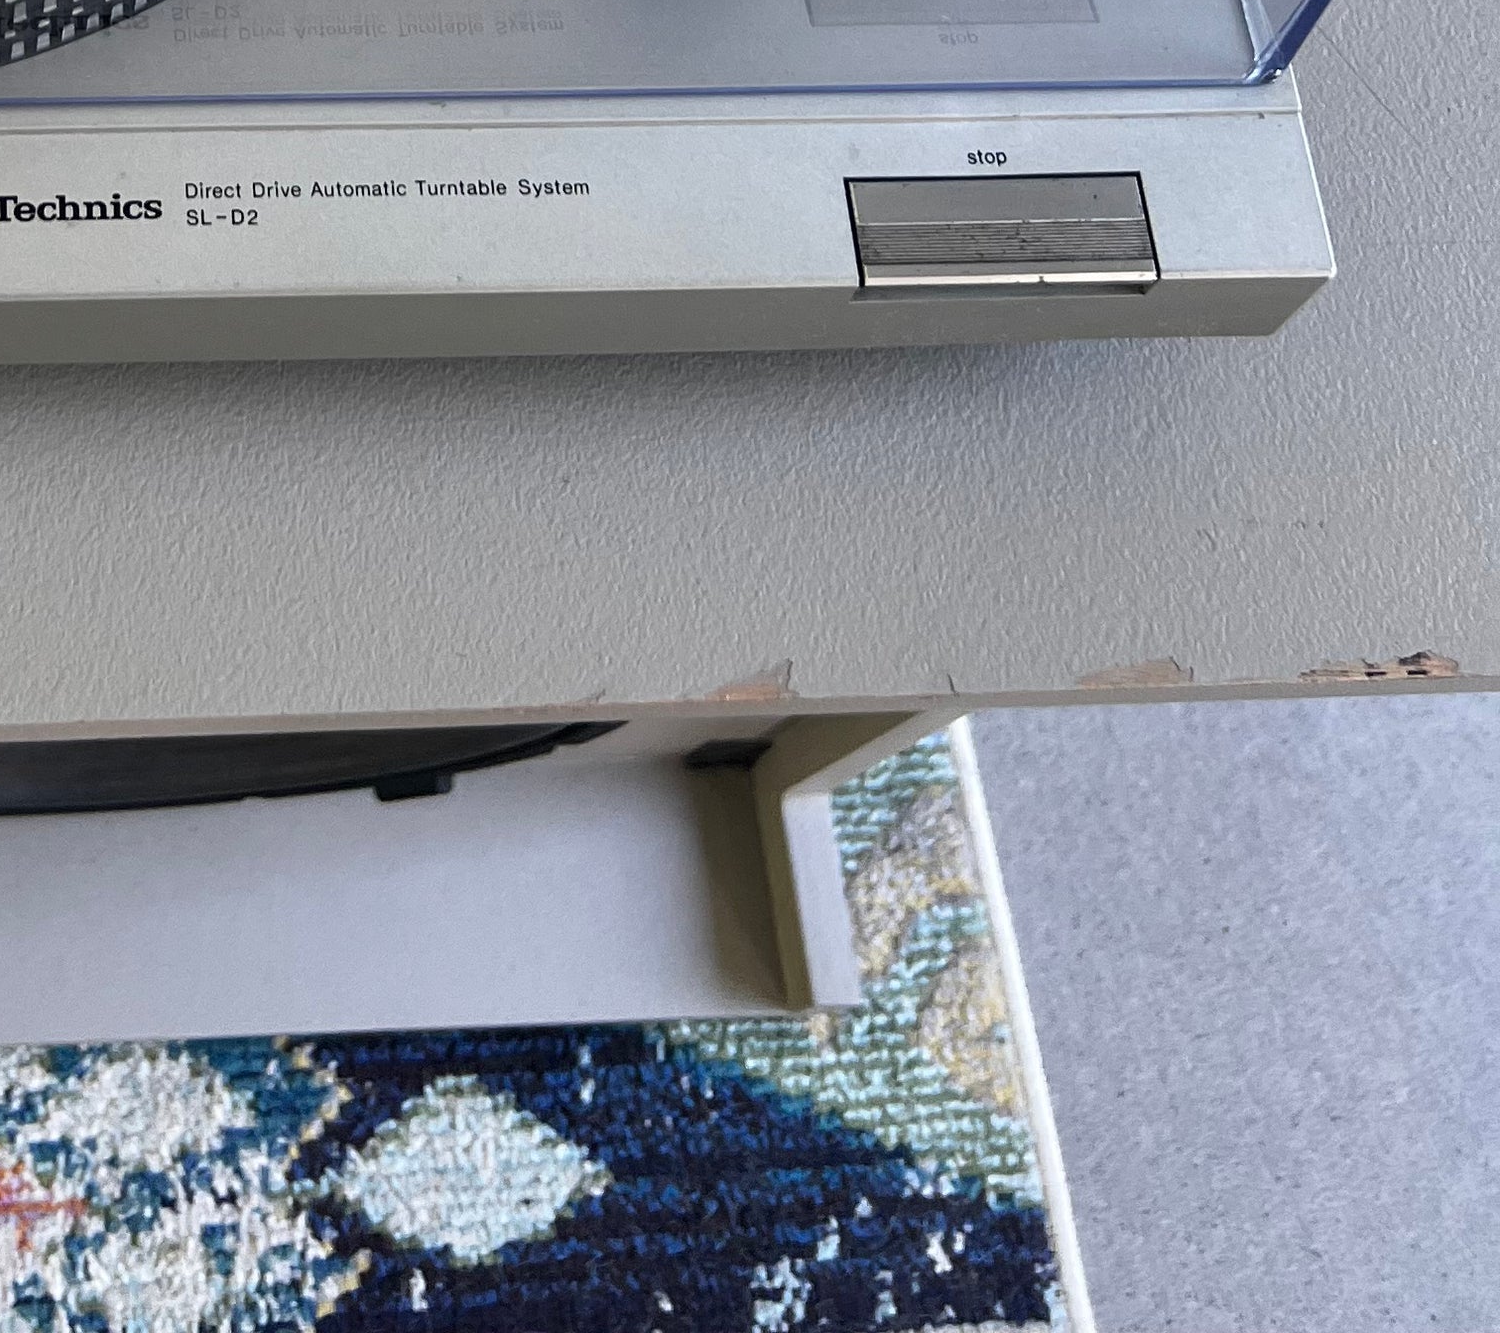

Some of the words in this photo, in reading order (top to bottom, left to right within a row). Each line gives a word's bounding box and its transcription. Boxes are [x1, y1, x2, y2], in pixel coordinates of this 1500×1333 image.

[966, 149, 1008, 167] stop
[184, 182, 242, 199] Direct
[252, 181, 302, 198] Drive
[310, 179, 407, 198] Automatic
[414, 179, 507, 197] Turntable
[518, 178, 591, 198] System
[186, 208, 259, 226] SL-D2
